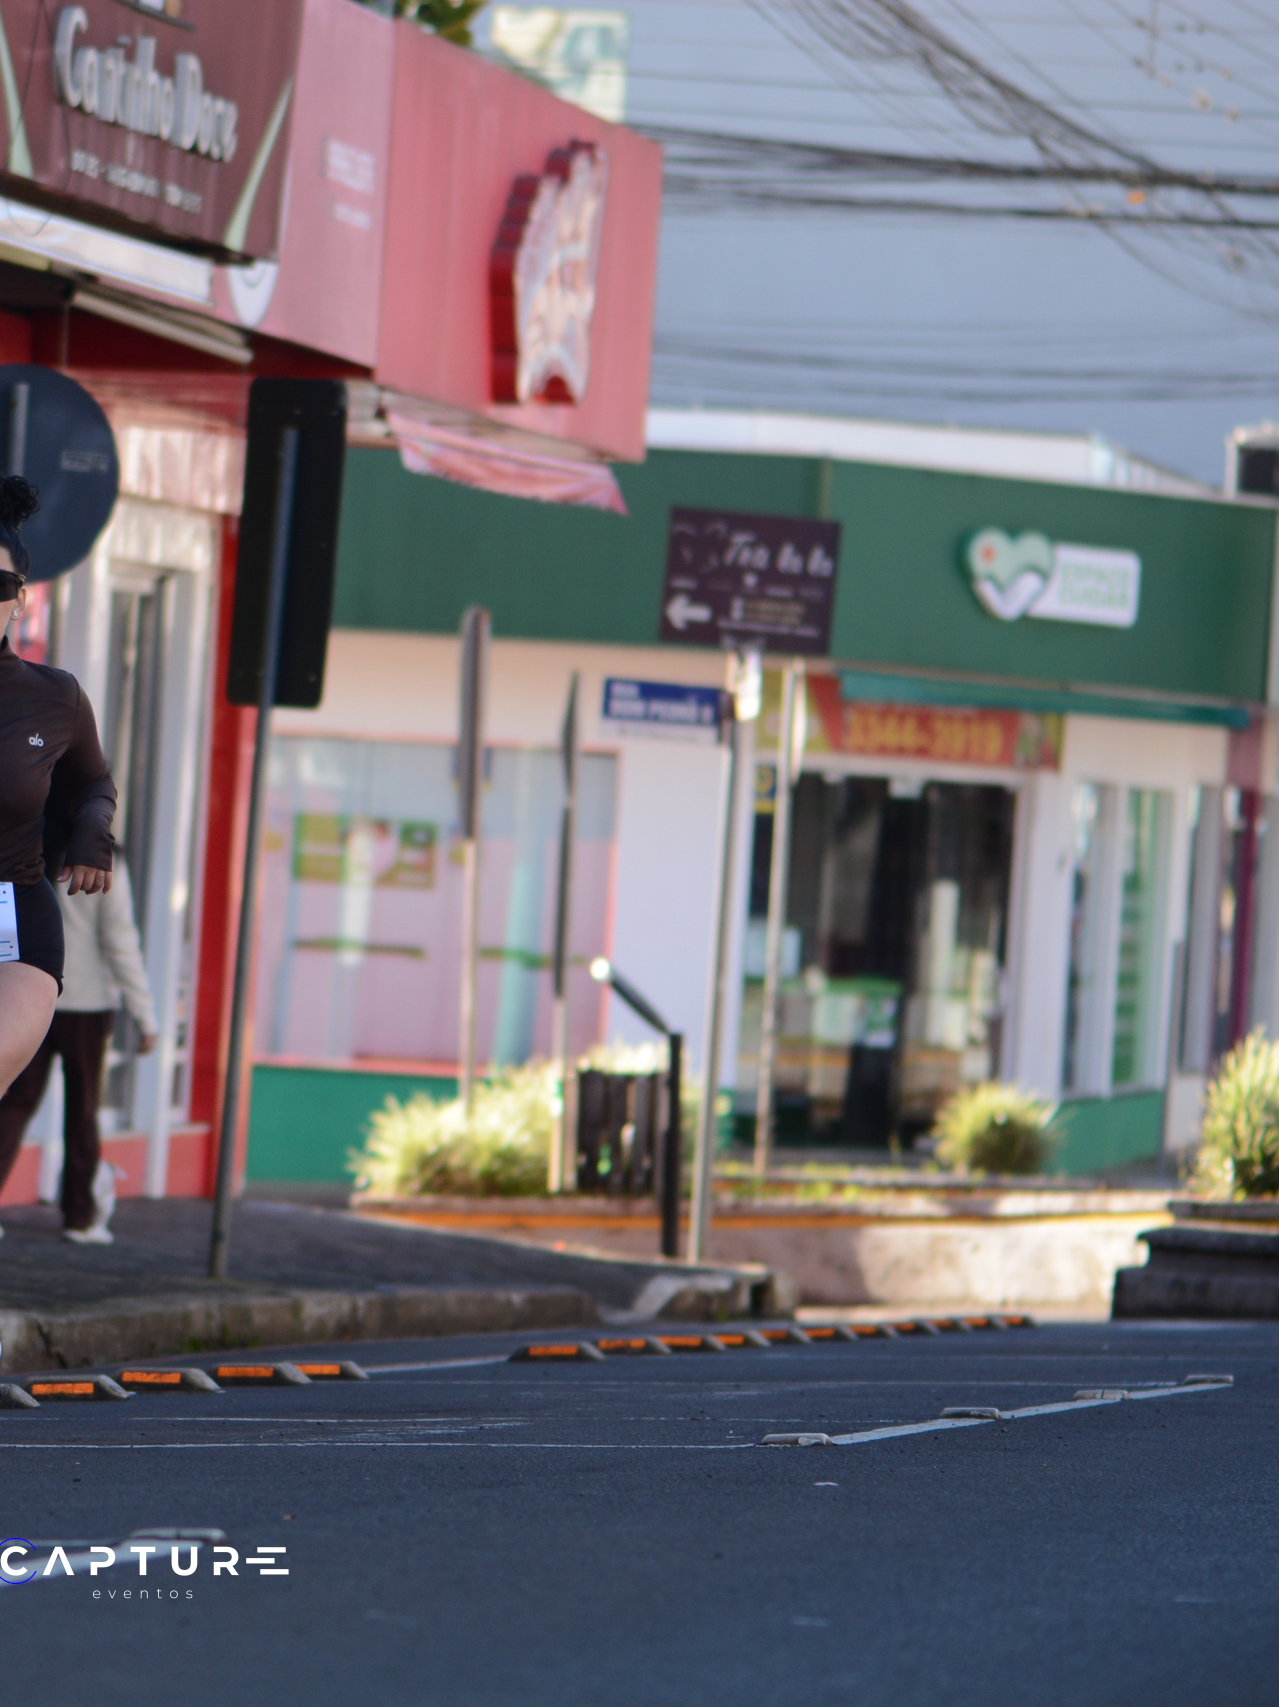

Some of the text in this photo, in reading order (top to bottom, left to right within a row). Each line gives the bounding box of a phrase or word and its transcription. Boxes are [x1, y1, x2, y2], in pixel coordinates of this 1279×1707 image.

[56, 6, 238, 163] Cantinho Doce
[29, 733, 44, 747] alo
